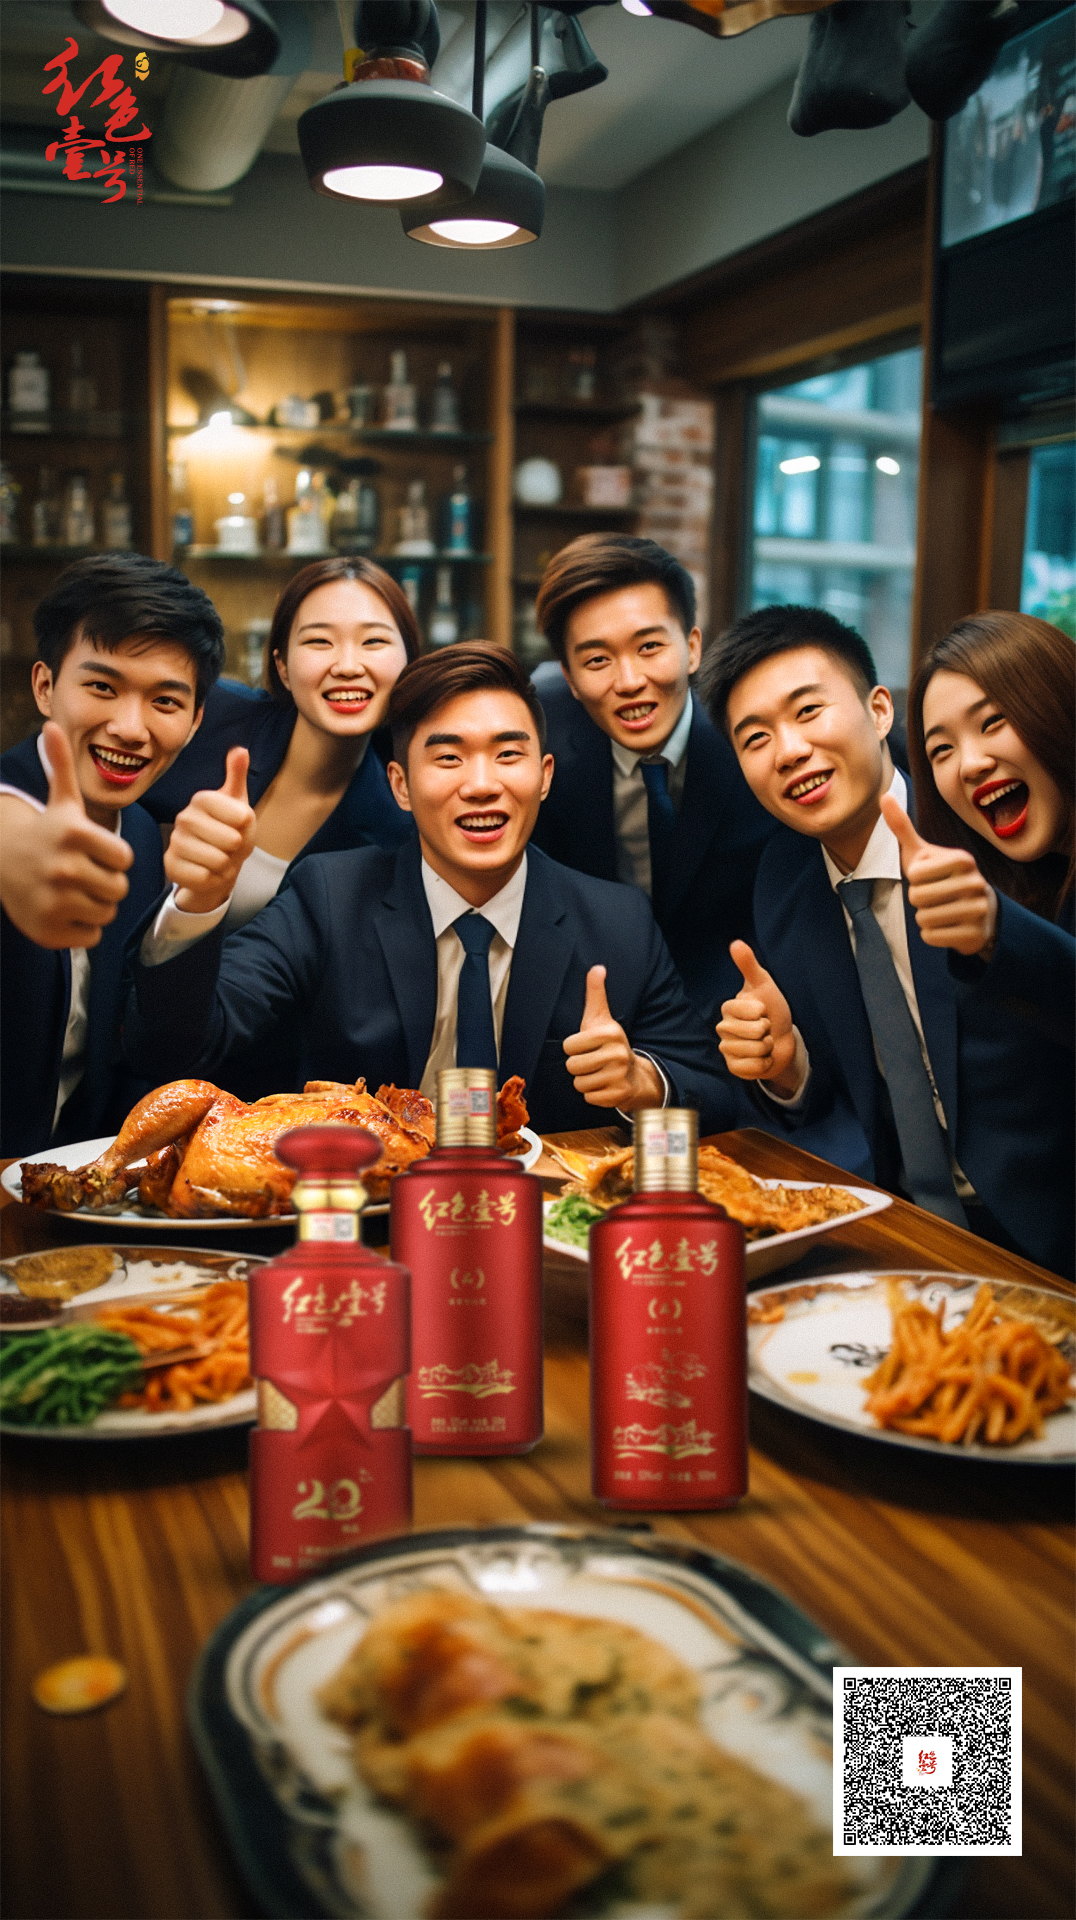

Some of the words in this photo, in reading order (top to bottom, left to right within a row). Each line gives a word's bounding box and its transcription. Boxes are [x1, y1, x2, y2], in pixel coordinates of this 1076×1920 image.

[418, 1189, 517, 1231] 红色壹号
[615, 1236, 719, 1280] 红色壹号
[292, 1478, 364, 1520] 20
